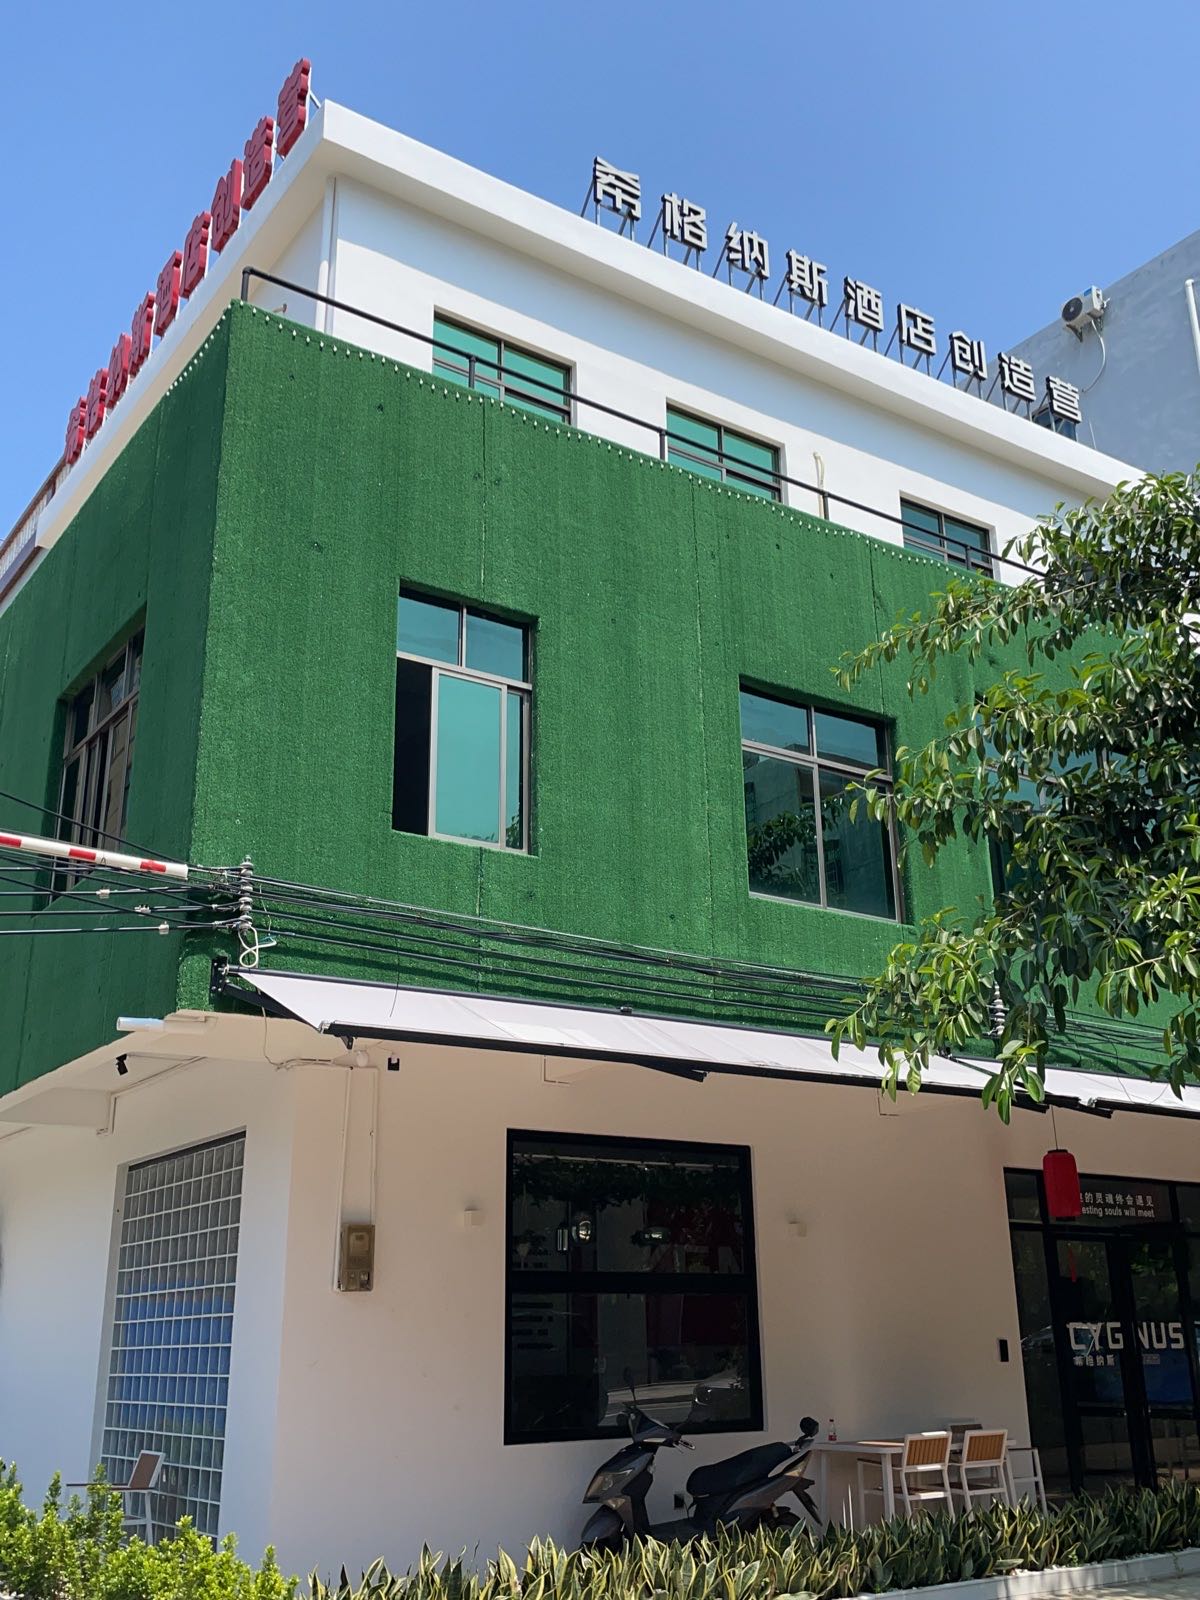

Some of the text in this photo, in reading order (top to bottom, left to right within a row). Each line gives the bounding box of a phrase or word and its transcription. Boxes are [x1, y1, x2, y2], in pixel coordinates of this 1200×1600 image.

[594, 156, 1081, 424] 希格纳斯酒店创造营
[1081, 1206, 1155, 1218] esting souls will meet
